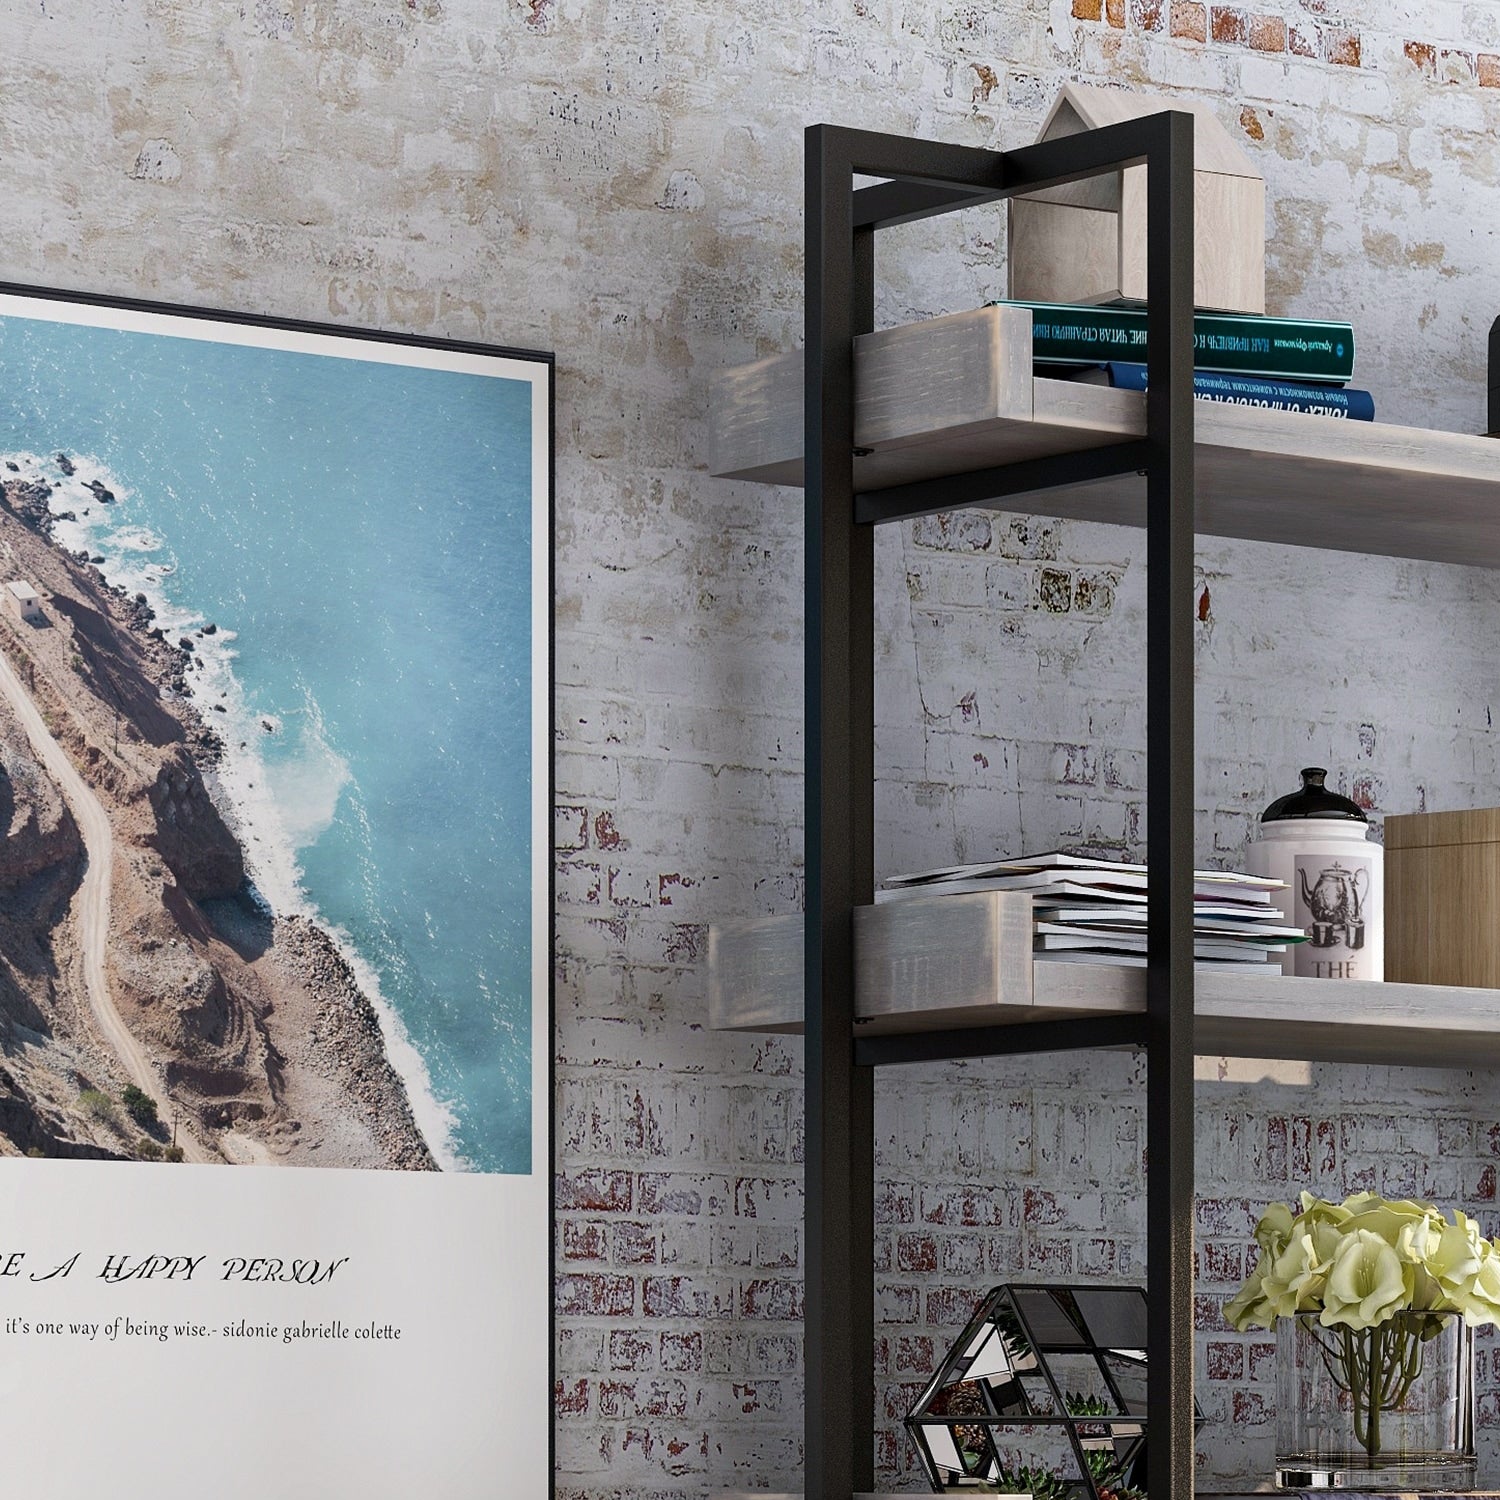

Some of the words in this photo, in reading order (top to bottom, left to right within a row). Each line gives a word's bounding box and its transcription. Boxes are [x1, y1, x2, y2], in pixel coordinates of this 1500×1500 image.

[1052, 325, 1098, 342] СТРАННУЮ
[1099, 328, 1128, 343] ЧИТАЯ
[1206, 335, 1250, 352] ПРИВЛЕЧЬ
[1251, 338, 1270, 353] КАК
[1311, 954, 1358, 978] THÉ
[0, 1252, 26, 1277] E
[29, 1252, 82, 1282] A
[96, 1253, 206, 1284] HAPPY
[222, 1256, 350, 1285] PERSON
[36, 1322, 64, 1334] one
[69, 1323, 99, 1341] way
[104, 1316, 122, 1341] of
[125, 1317, 169, 1342] being
[222, 1320, 278, 1339] sidonie
[282, 1321, 350, 1344] gabrielle
[354, 1323, 402, 1341] colette
